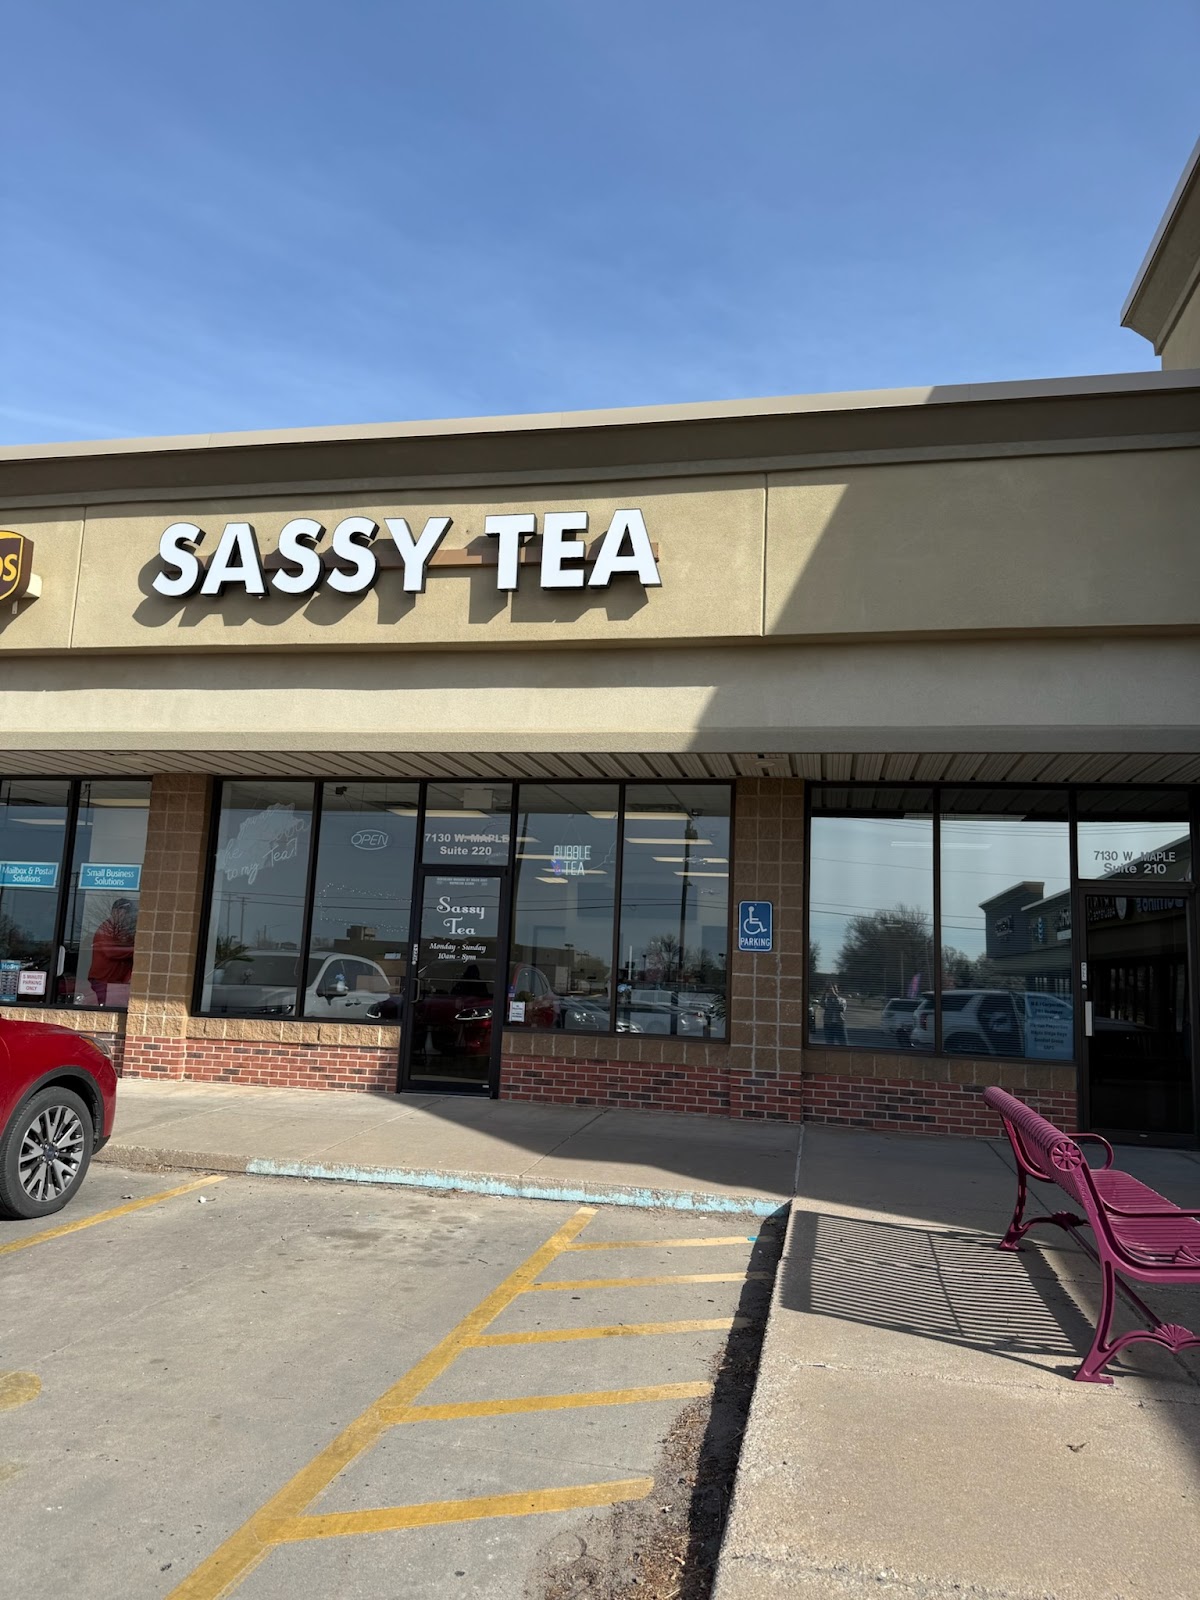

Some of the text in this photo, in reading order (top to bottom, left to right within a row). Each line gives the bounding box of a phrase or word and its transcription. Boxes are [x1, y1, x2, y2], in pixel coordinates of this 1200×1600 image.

[151, 508, 662, 598] SASSY TEA
[351, 833, 389, 846] OPEN
[425, 833, 509, 843] 7130 W. MAPLE
[440, 845, 492, 855] Suite 220
[1094, 850, 1118, 861] 7130
[1140, 851, 1176, 862] MAPLE
[553, 844, 592, 876] BUBBLE TEA
[34, 866, 54, 876] Postal
[87, 868, 134, 878] Small Business
[241, 863, 260, 885] my
[1104, 862, 1167, 874] Suite 210
[12, 874, 41, 883] Solutions
[94, 877, 125, 886] Solutions
[436, 896, 485, 920] Sassy
[443, 916, 476, 935] Tea
[429, 942, 457, 953] Monday
[461, 943, 487, 954] Sunday
[741, 937, 771, 947] PARKING
[437, 952, 456, 960] 10am
[461, 953, 477, 963] 8pm
